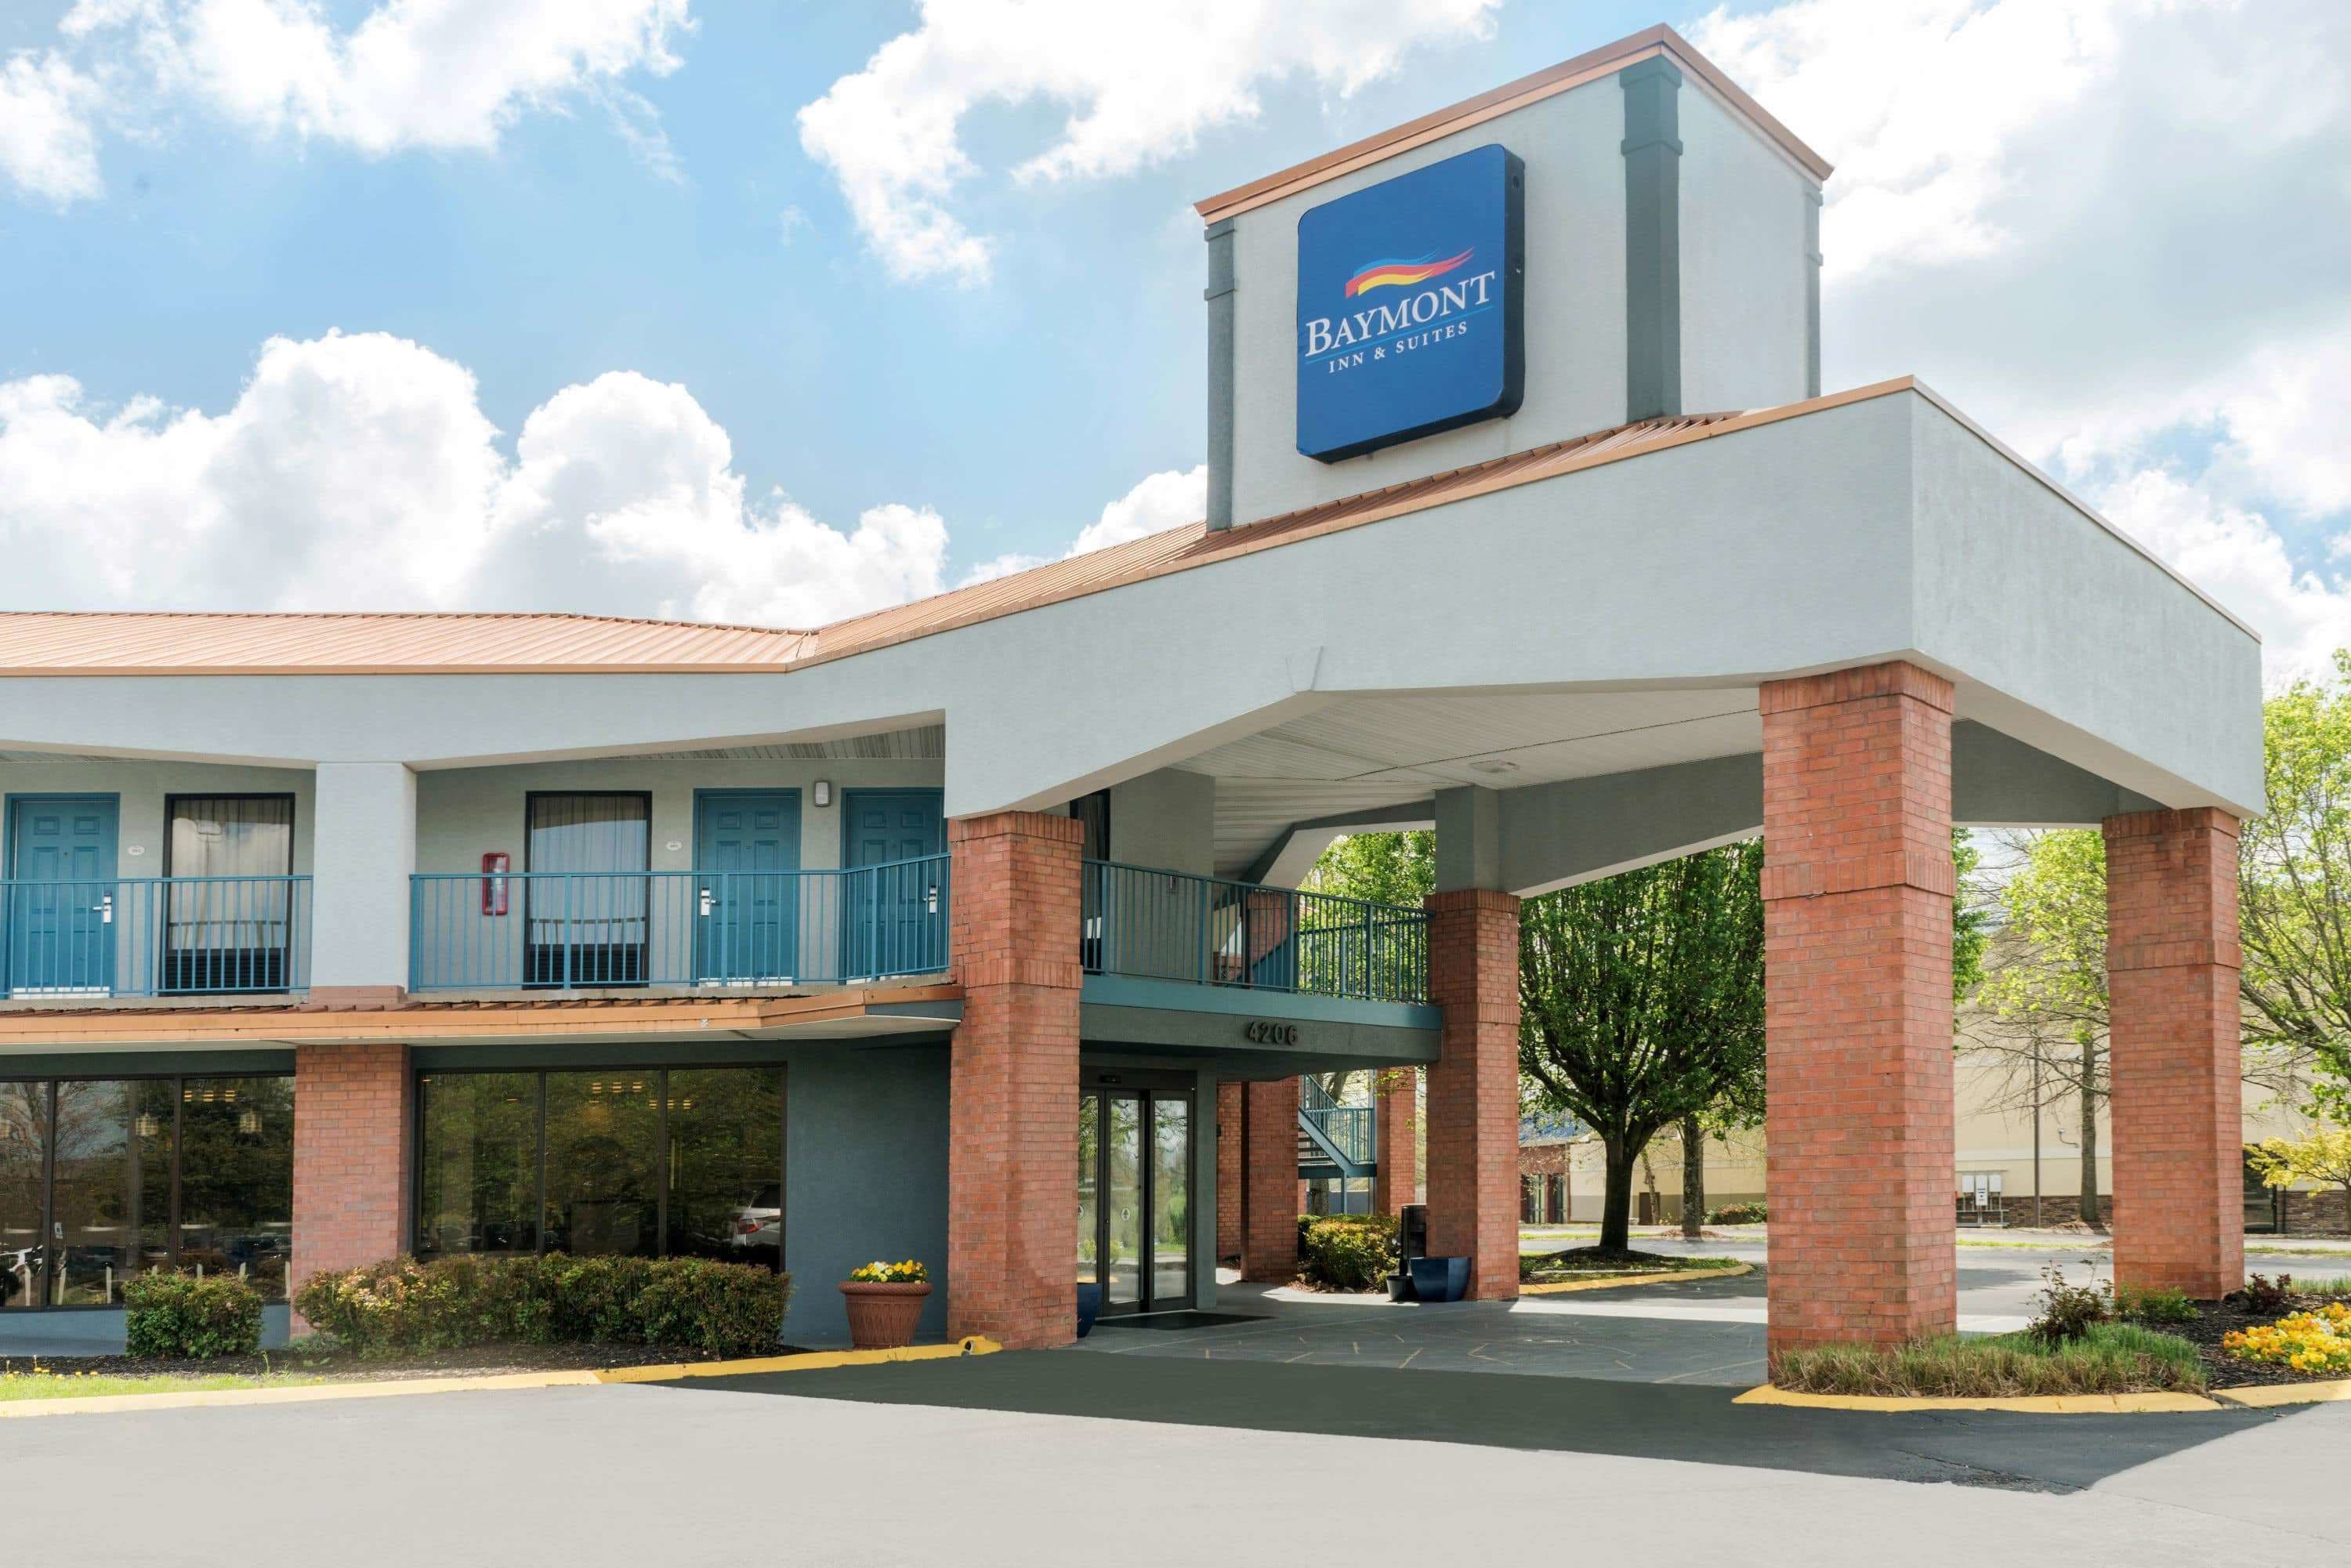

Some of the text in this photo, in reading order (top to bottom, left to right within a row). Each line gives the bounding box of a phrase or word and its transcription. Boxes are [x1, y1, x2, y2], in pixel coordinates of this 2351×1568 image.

[1305, 270, 1495, 357] BAYMONT
[1329, 321, 1468, 373] INN & SUITES
[1248, 1021, 1298, 1045] 4206
